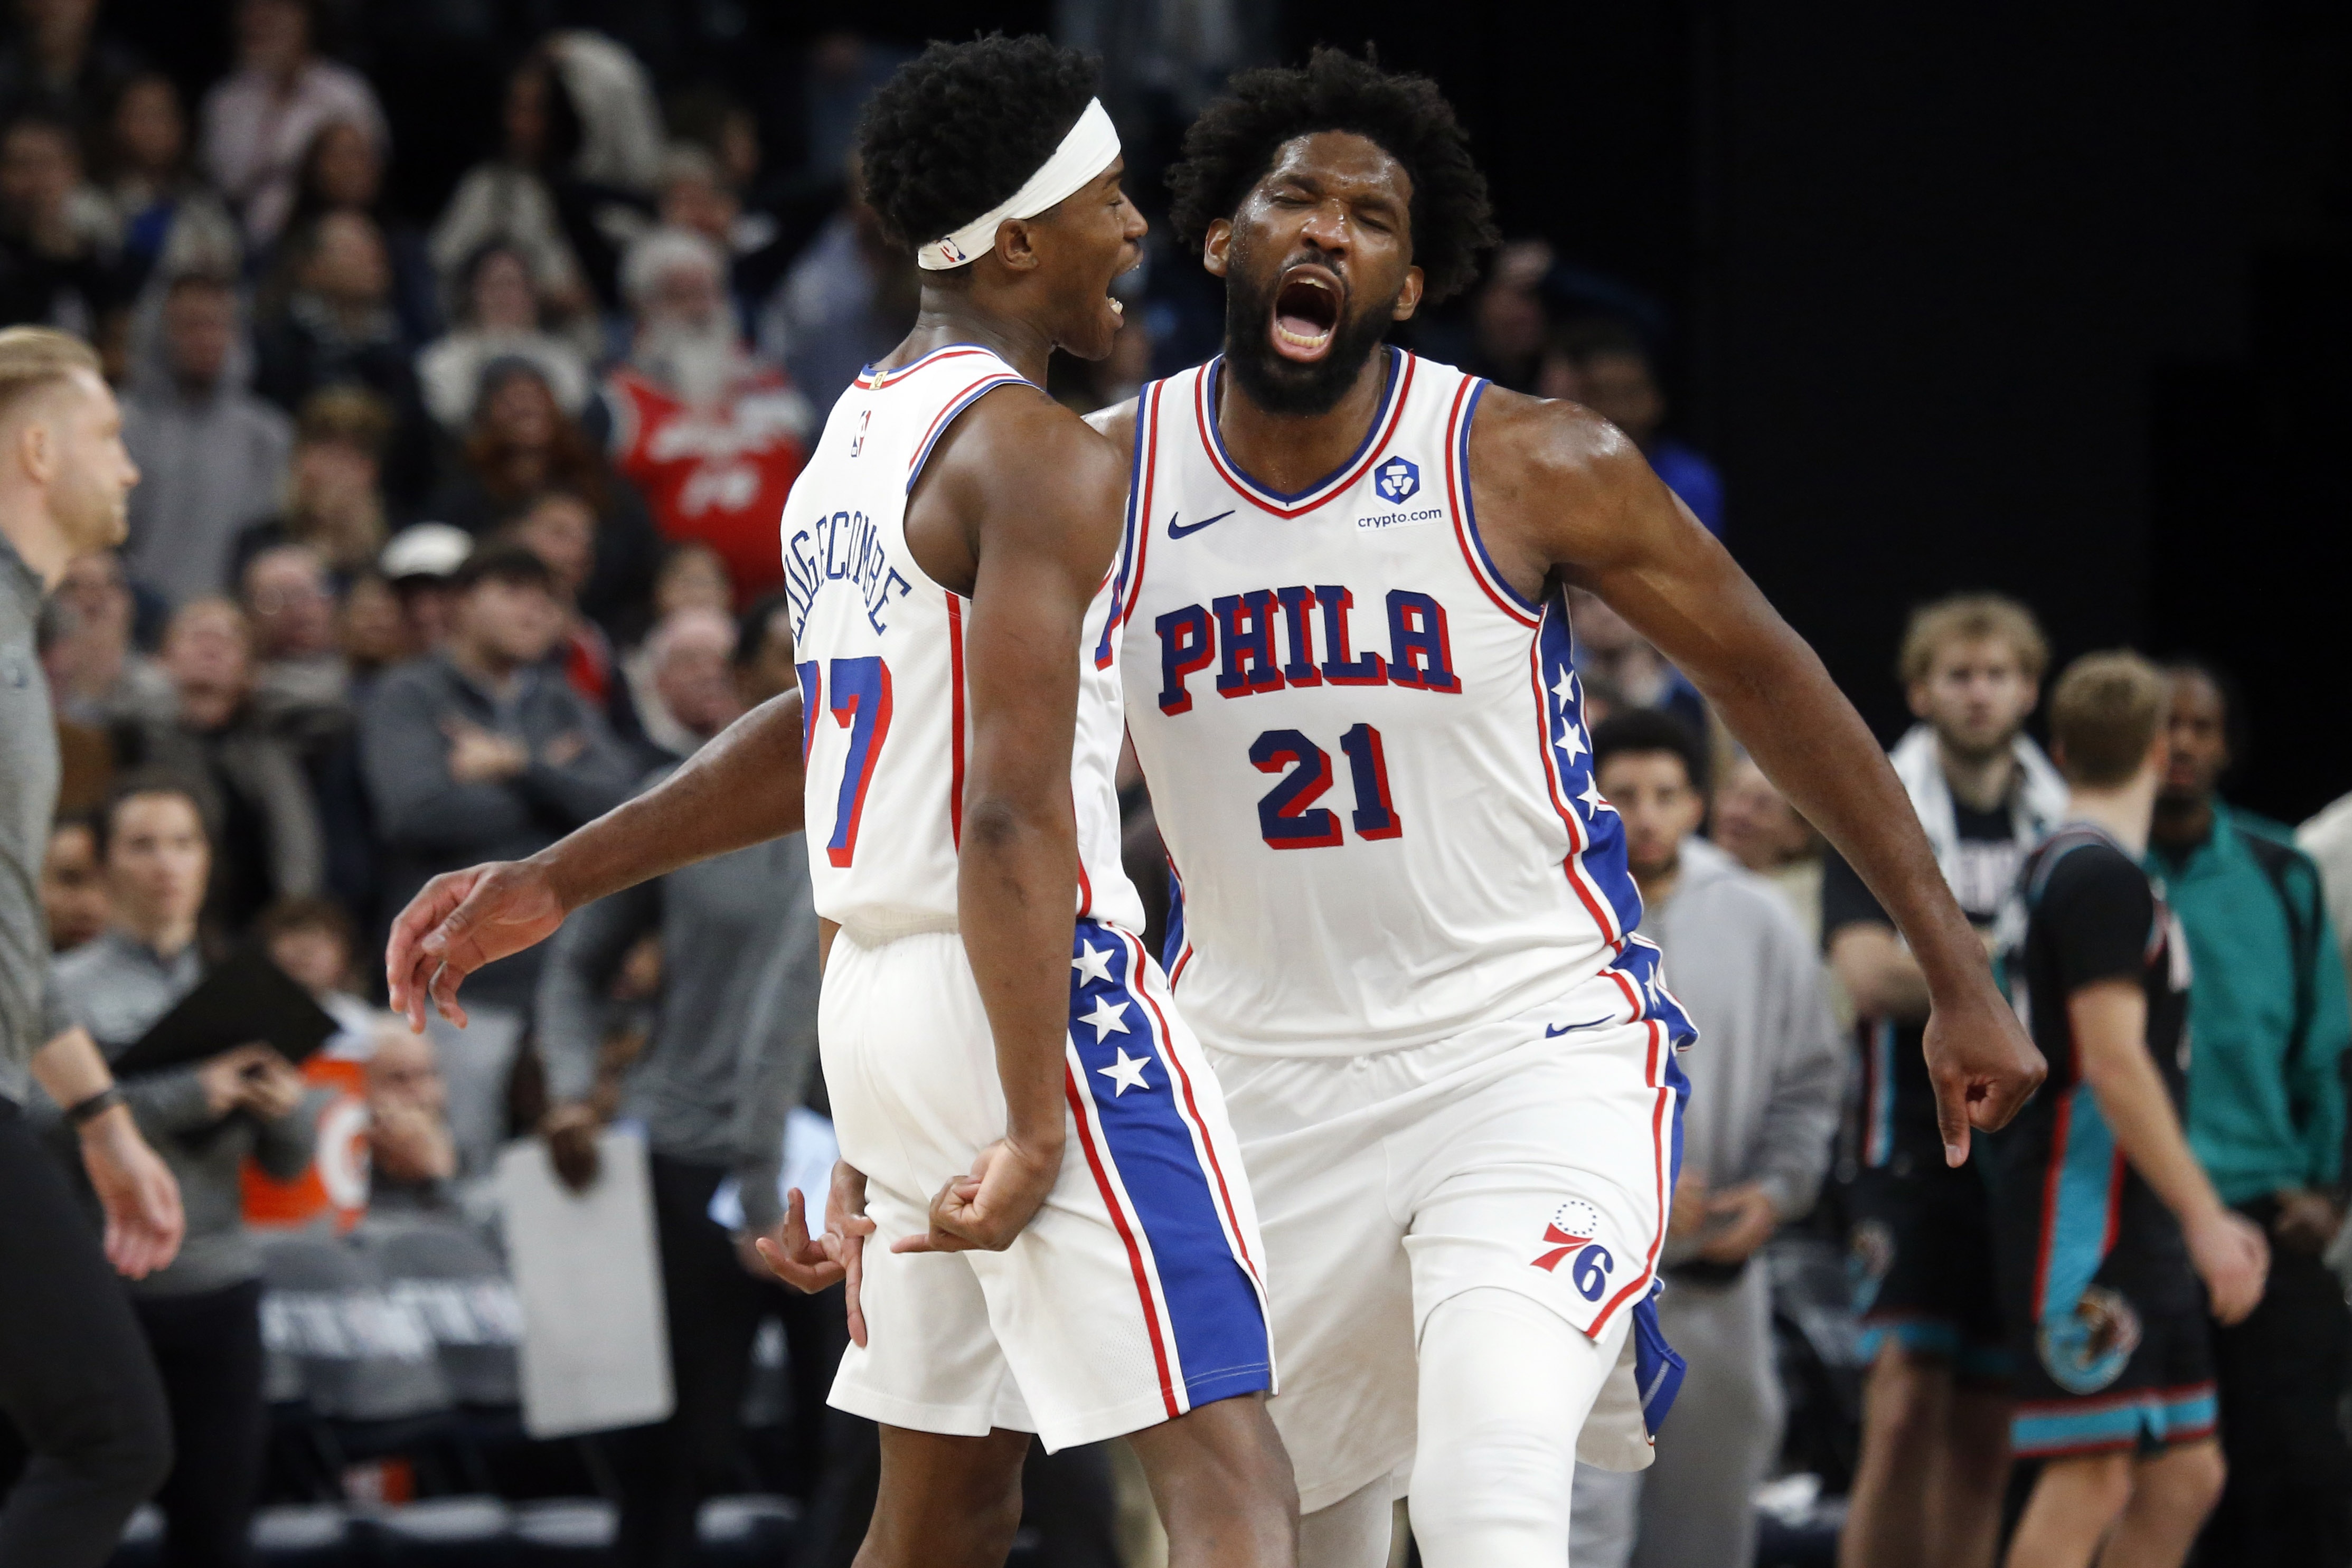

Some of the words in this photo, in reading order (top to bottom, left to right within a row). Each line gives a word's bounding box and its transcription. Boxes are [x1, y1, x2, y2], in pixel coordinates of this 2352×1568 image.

[1358, 508, 1442, 528] crypto.com
[1155, 584, 1463, 717] PHILA
[1248, 723, 1403, 851] 21
[1529, 1222, 1614, 1302] 76
